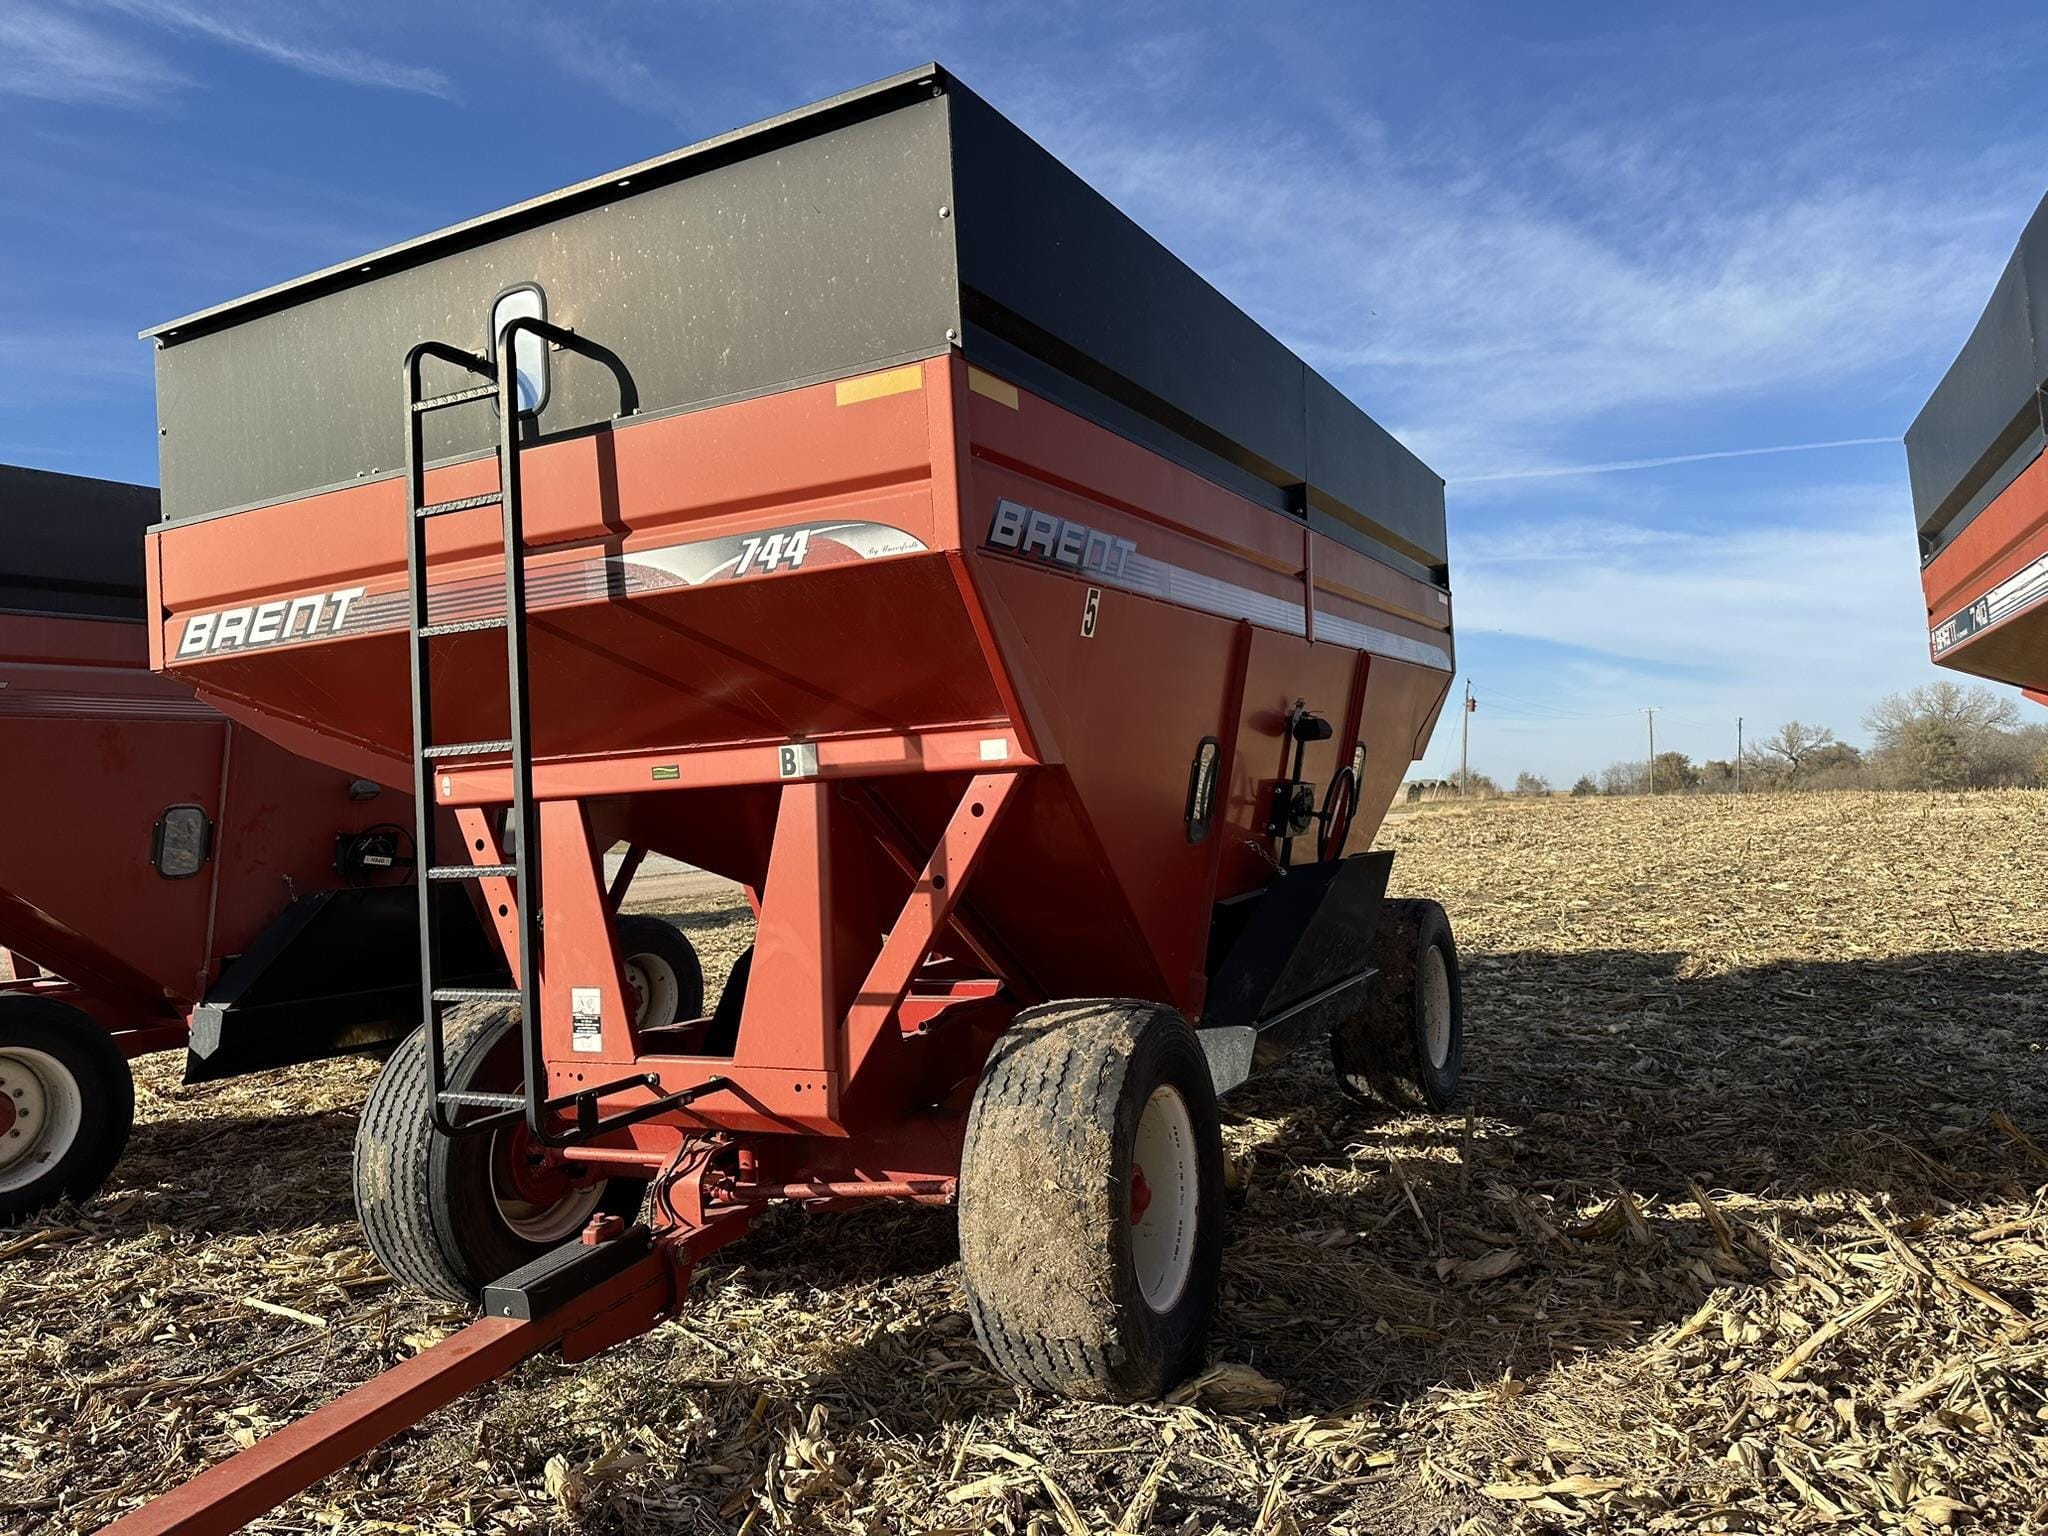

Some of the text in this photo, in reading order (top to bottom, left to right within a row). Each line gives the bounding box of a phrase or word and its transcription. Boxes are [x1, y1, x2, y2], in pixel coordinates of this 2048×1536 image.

[733, 528, 812, 577] 744
[987, 497, 1138, 578] BRENT
[177, 585, 368, 657] BRENT
[1083, 588, 1099, 636] 5
[780, 747, 797, 776] B
